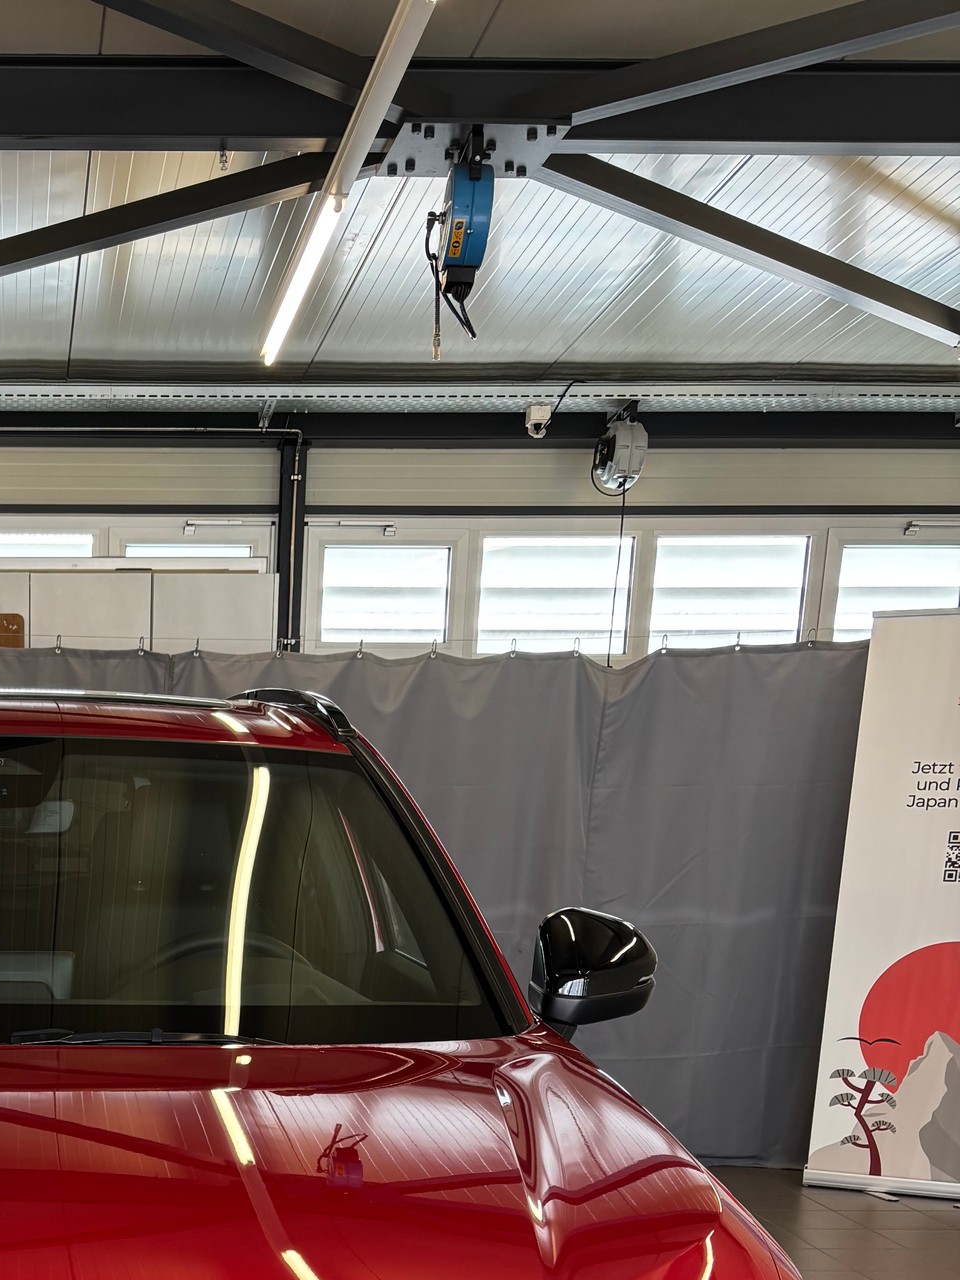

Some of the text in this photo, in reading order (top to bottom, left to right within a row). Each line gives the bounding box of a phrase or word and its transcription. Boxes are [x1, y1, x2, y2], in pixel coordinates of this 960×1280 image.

[911, 761, 955, 775] Jetzt
[916, 777, 951, 791] und
[906, 794, 959, 811] Japan
